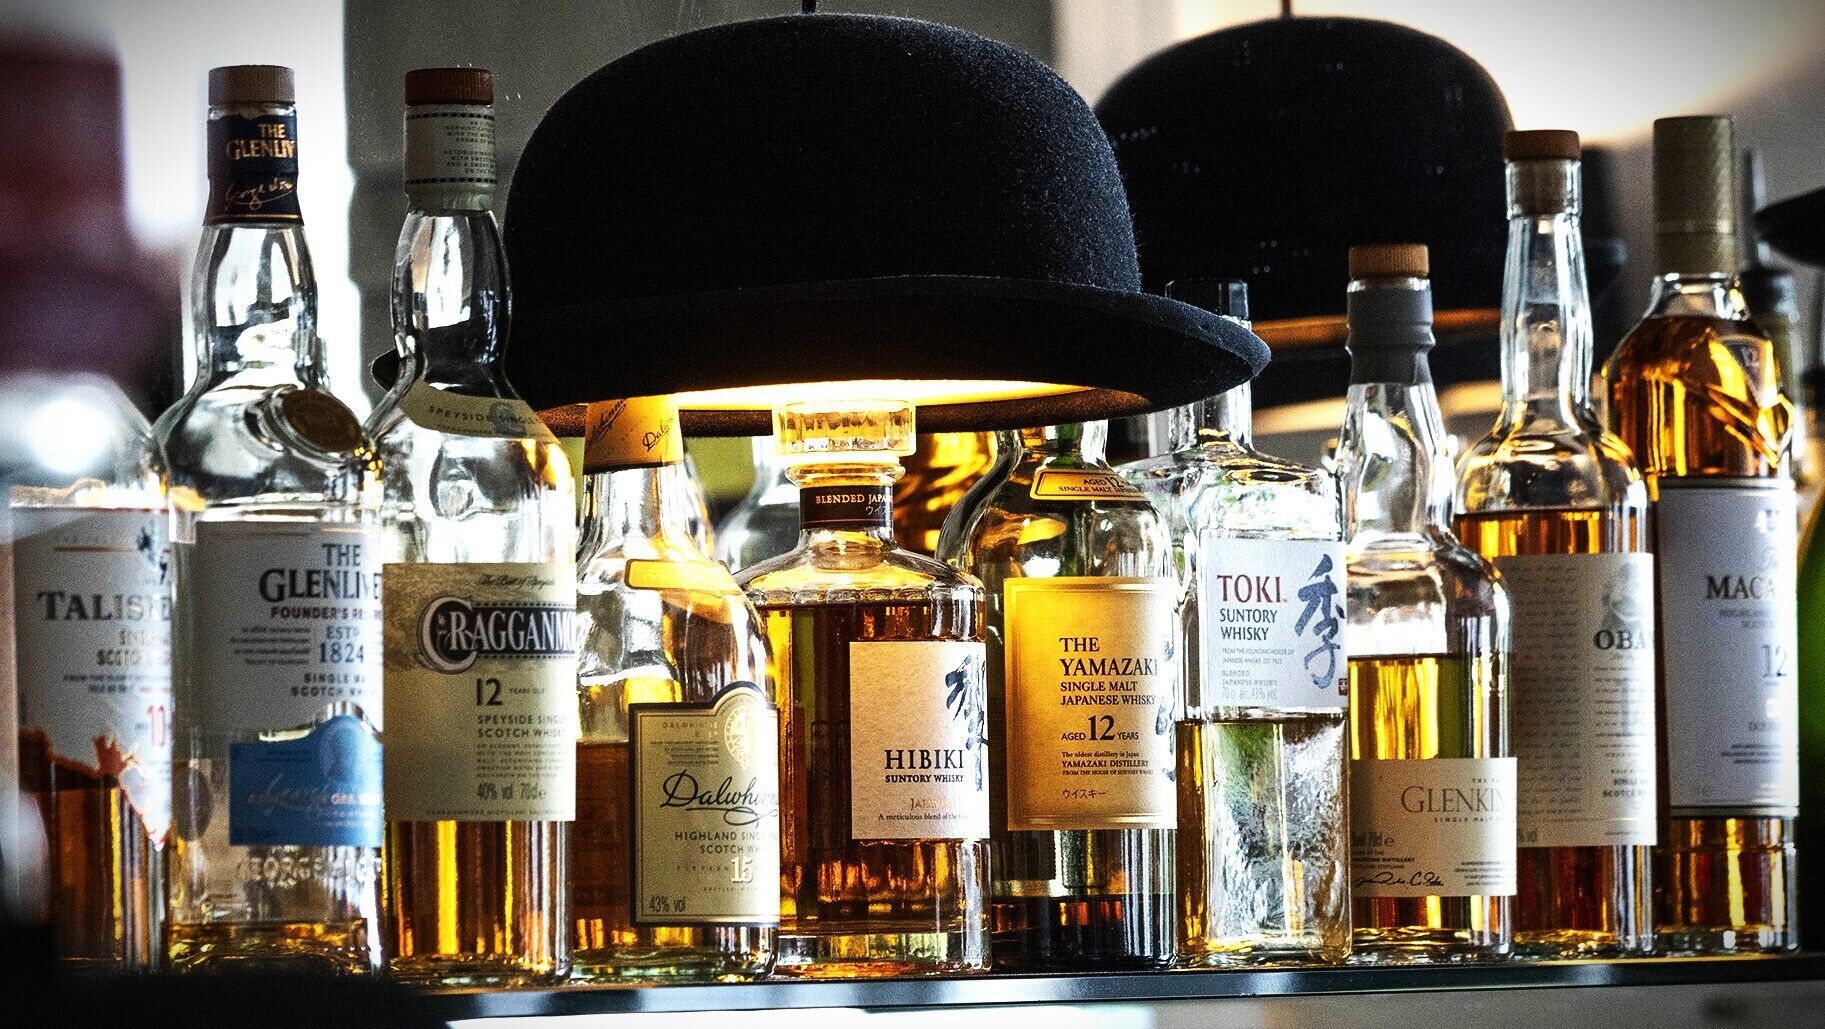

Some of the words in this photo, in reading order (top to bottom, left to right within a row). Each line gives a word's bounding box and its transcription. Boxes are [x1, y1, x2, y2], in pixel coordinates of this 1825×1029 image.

[258, 123, 286, 138] THE
[1083, 478, 1107, 486] AGED
[1105, 476, 1124, 488] 12
[815, 493, 865, 505] BLENDED
[321, 543, 361, 567] THE
[1217, 574, 1282, 604] TOKI
[36, 590, 171, 622] TALISE
[270, 606, 348, 620] FOUNDER'S
[1219, 608, 1278, 623] SUNTORY
[1220, 626, 1270, 641] WHISKY
[1059, 637, 1101, 653] THE
[319, 642, 364, 664] 1824
[1059, 657, 1158, 677] YAMAZAKI
[1761, 644, 1788, 678] 12
[303, 672, 349, 685] SINGLE
[1222, 678, 1252, 686] JAPANESE
[289, 685, 344, 698] SCOTCH
[476, 677, 504, 707] 12
[1060, 681, 1106, 692] SINGLE
[1109, 681, 1139, 692] MALT
[1060, 694, 1119, 706] JAPANESE
[1121, 694, 1156, 706] WHISKY
[477, 714, 533, 725] SPEYSIDE
[477, 727, 530, 739] SCOTCH
[1061, 732, 1087, 741] AGED
[1088, 714, 1116, 741] 12
[1117, 731, 1139, 741] YEARS
[883, 749, 965, 770] HIBIKI
[1061, 750, 1074, 758] The
[1074, 750, 1093, 758] oldest
[1093, 750, 1118, 759] distillery
[1119, 750, 1125, 758] in
[1125, 750, 1139, 759] Japan
[1061, 760, 1107, 768] YAMAZAKI
[1109, 760, 1149, 768] DISTILLERY
[884, 774, 932, 784] SUNTORY
[933, 774, 965, 784] WHISKY
[1062, 788, 1107, 800] ウイスキー
[878, 812, 885, 821] A
[886, 812, 923, 821] meticulous
[923, 812, 941, 821] blend
[941, 812, 949, 821] of
[674, 831, 737, 842] HIGHLAND
[741, 831, 765, 842] SING
[699, 844, 744, 855] SCOTCH
[730, 856, 754, 884] 15
[649, 895, 670, 913] 43%
[673, 895, 687, 913] vol
